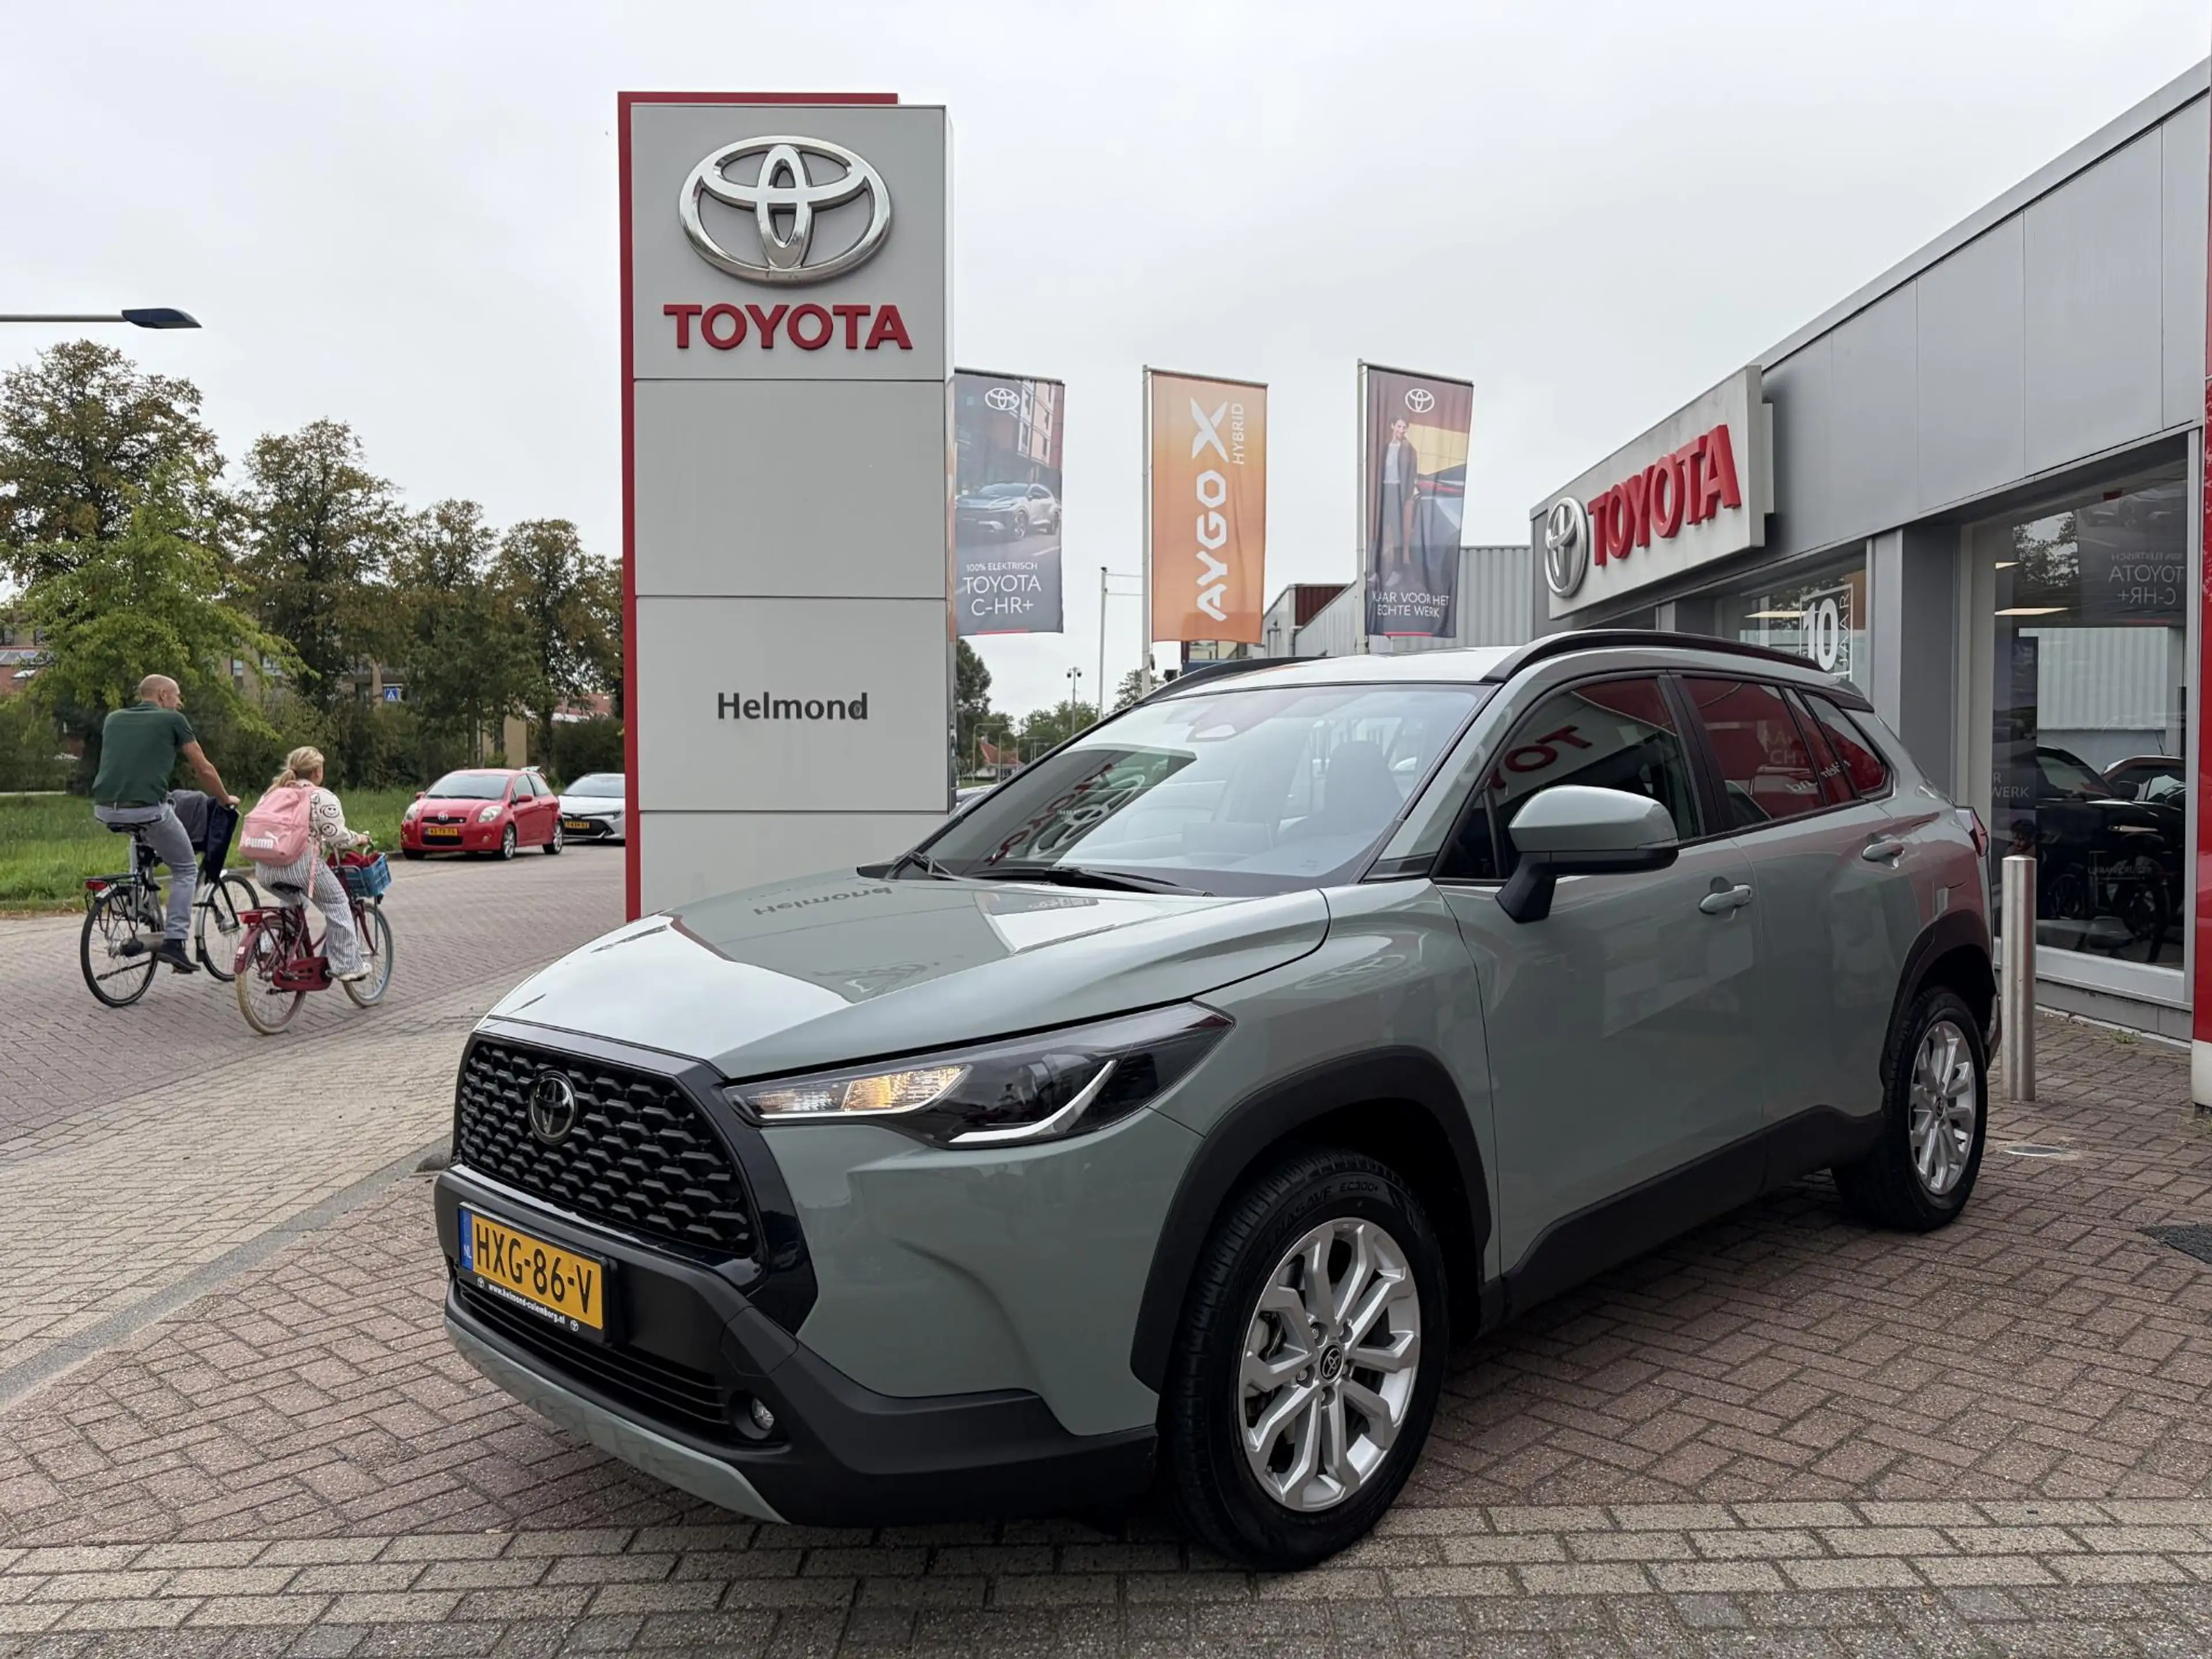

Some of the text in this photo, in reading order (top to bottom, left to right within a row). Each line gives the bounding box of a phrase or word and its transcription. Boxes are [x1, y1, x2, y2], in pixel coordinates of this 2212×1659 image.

[664, 303, 913, 350] TOYOTA
[1231, 403, 1245, 465] HYBRID
[1190, 397, 1229, 621] AYGO X
[1588, 423, 1742, 567] TOYOTA
[962, 574, 1042, 594] TOYOTA
[966, 562, 1037, 572] 100% ELEKTRISCH
[971, 596, 1034, 616] C-HR+
[1377, 604, 1440, 618] ECHTE WERK
[1401, 592, 1431, 604] VOOR
[1433, 594, 1449, 606] HET
[1803, 598, 1838, 671] 10
[1839, 593, 1850, 668] JAAR
[718, 692, 868, 719] Helmond
[463, 1244, 472, 1259] NL
[476, 1223, 592, 1314] HXG-86-V
